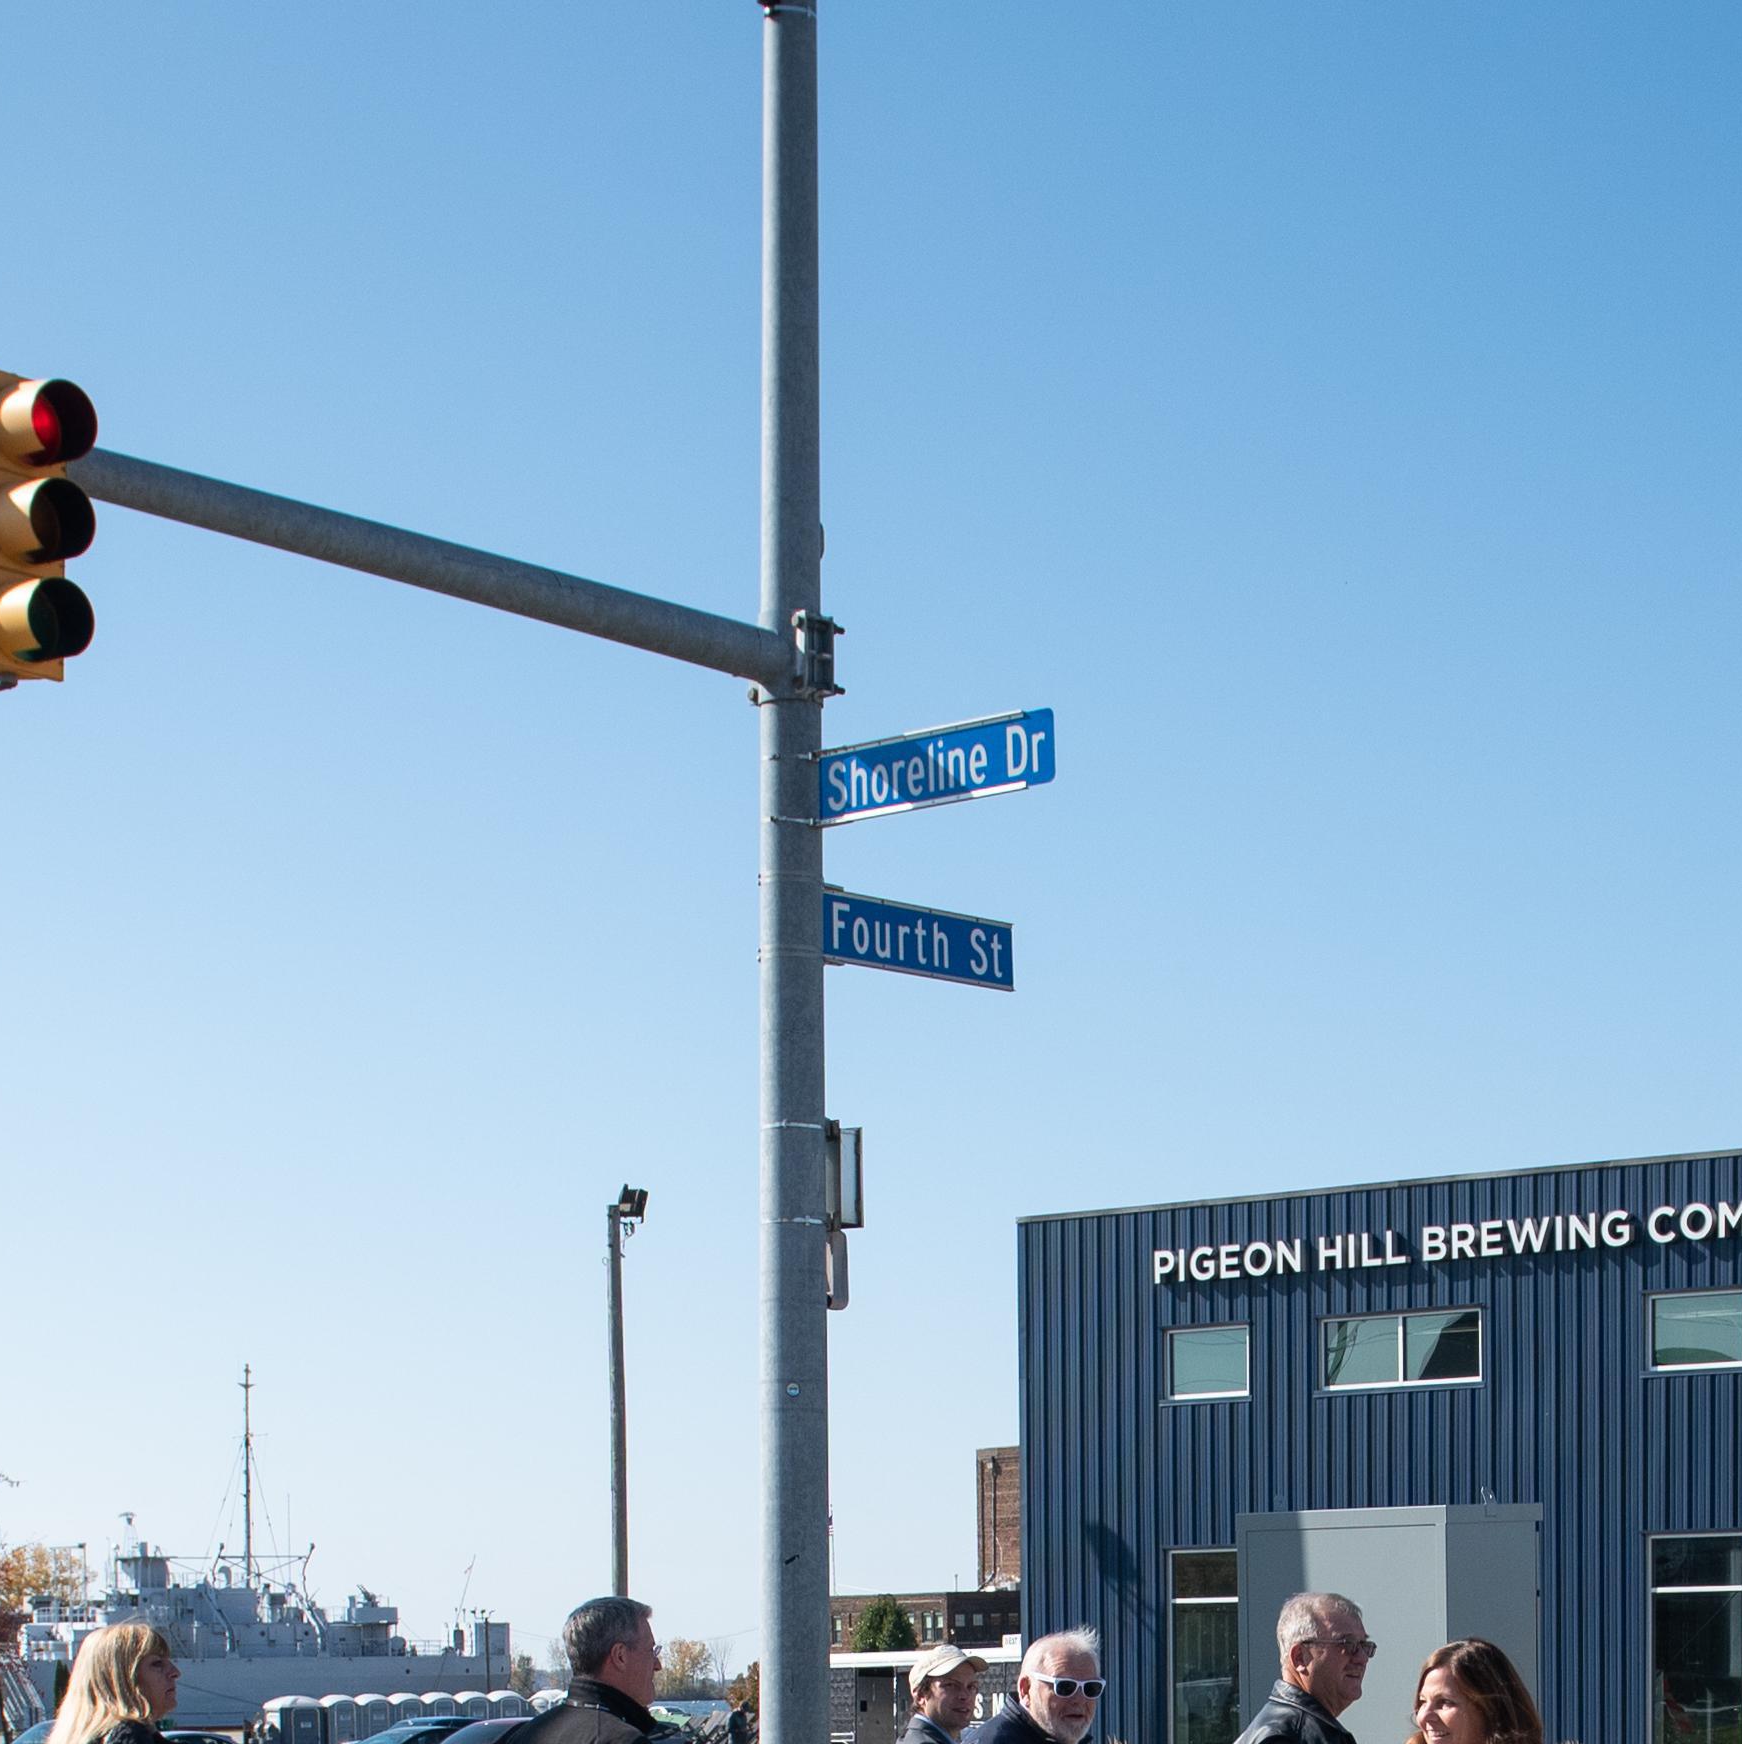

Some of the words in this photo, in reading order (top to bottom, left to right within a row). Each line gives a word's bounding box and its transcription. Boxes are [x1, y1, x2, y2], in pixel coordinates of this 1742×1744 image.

[827, 740, 988, 812] Shoreline
[1005, 723, 1046, 778] Dr
[832, 902, 950, 969] Fourth
[969, 928, 1003, 978] St
[1154, 1239, 1301, 1284] PIGEON
[1319, 1230, 1408, 1271] HILL
[1422, 1210, 1631, 1262] BREWING
